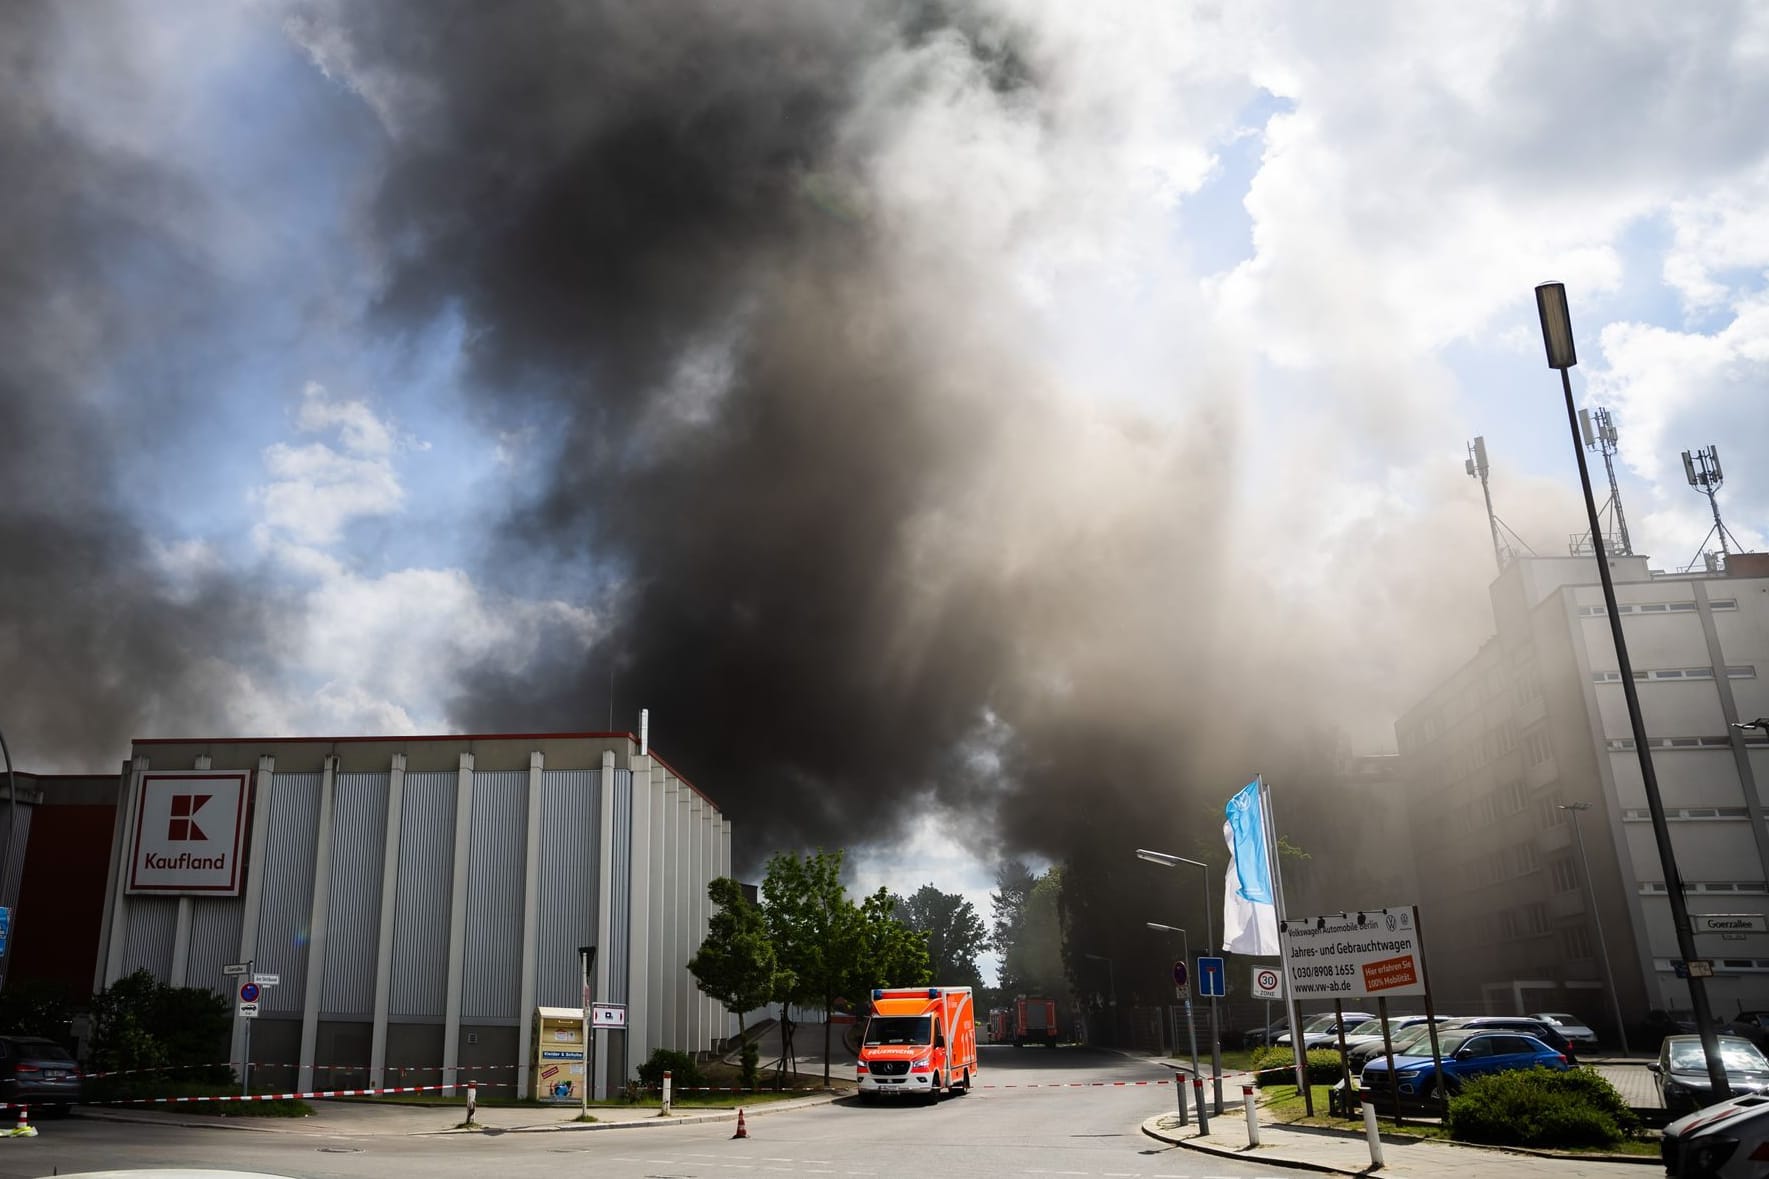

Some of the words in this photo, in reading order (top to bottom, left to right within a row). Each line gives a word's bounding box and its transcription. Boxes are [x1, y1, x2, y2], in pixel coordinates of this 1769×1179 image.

[144, 853, 225, 870] Kaufland
[1288, 927, 1322, 938] Volkswagen
[1323, 922, 1358, 934] Automobile
[1291, 947, 1318, 958] Jahres-
[1320, 944, 1335, 956] und
[1337, 939, 1412, 954] Gebrauchtwagen
[1297, 966, 1333, 978] 030/8908
[1335, 964, 1355, 976] 1655
[1365, 967, 1377, 976] Hier
[1378, 963, 1402, 974] erfahren
[1403, 960, 1412, 969] Sie
[1262, 976, 1273, 985] 30
[1295, 980, 1351, 993] www.vw-ab.de
